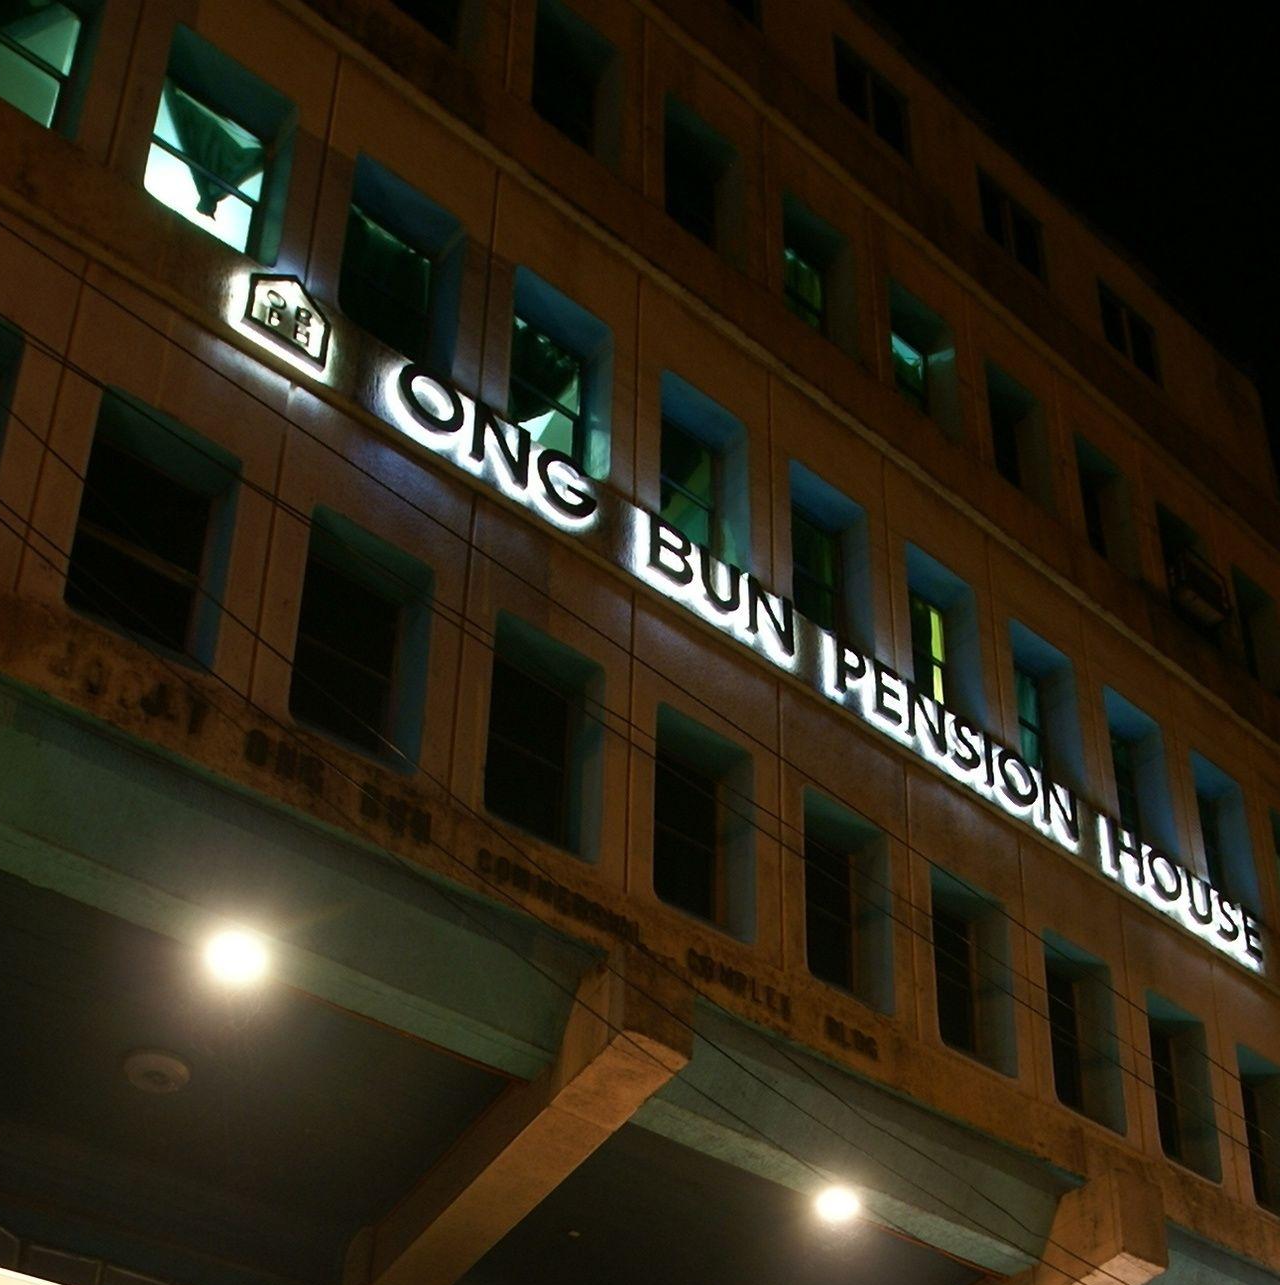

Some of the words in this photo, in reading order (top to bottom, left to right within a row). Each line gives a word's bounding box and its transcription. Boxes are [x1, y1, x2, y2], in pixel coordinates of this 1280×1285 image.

[397, 360, 598, 522] ONG
[646, 509, 795, 658] BUN
[831, 643, 1082, 845] PENSION
[1110, 811, 1264, 964] HOUSE
